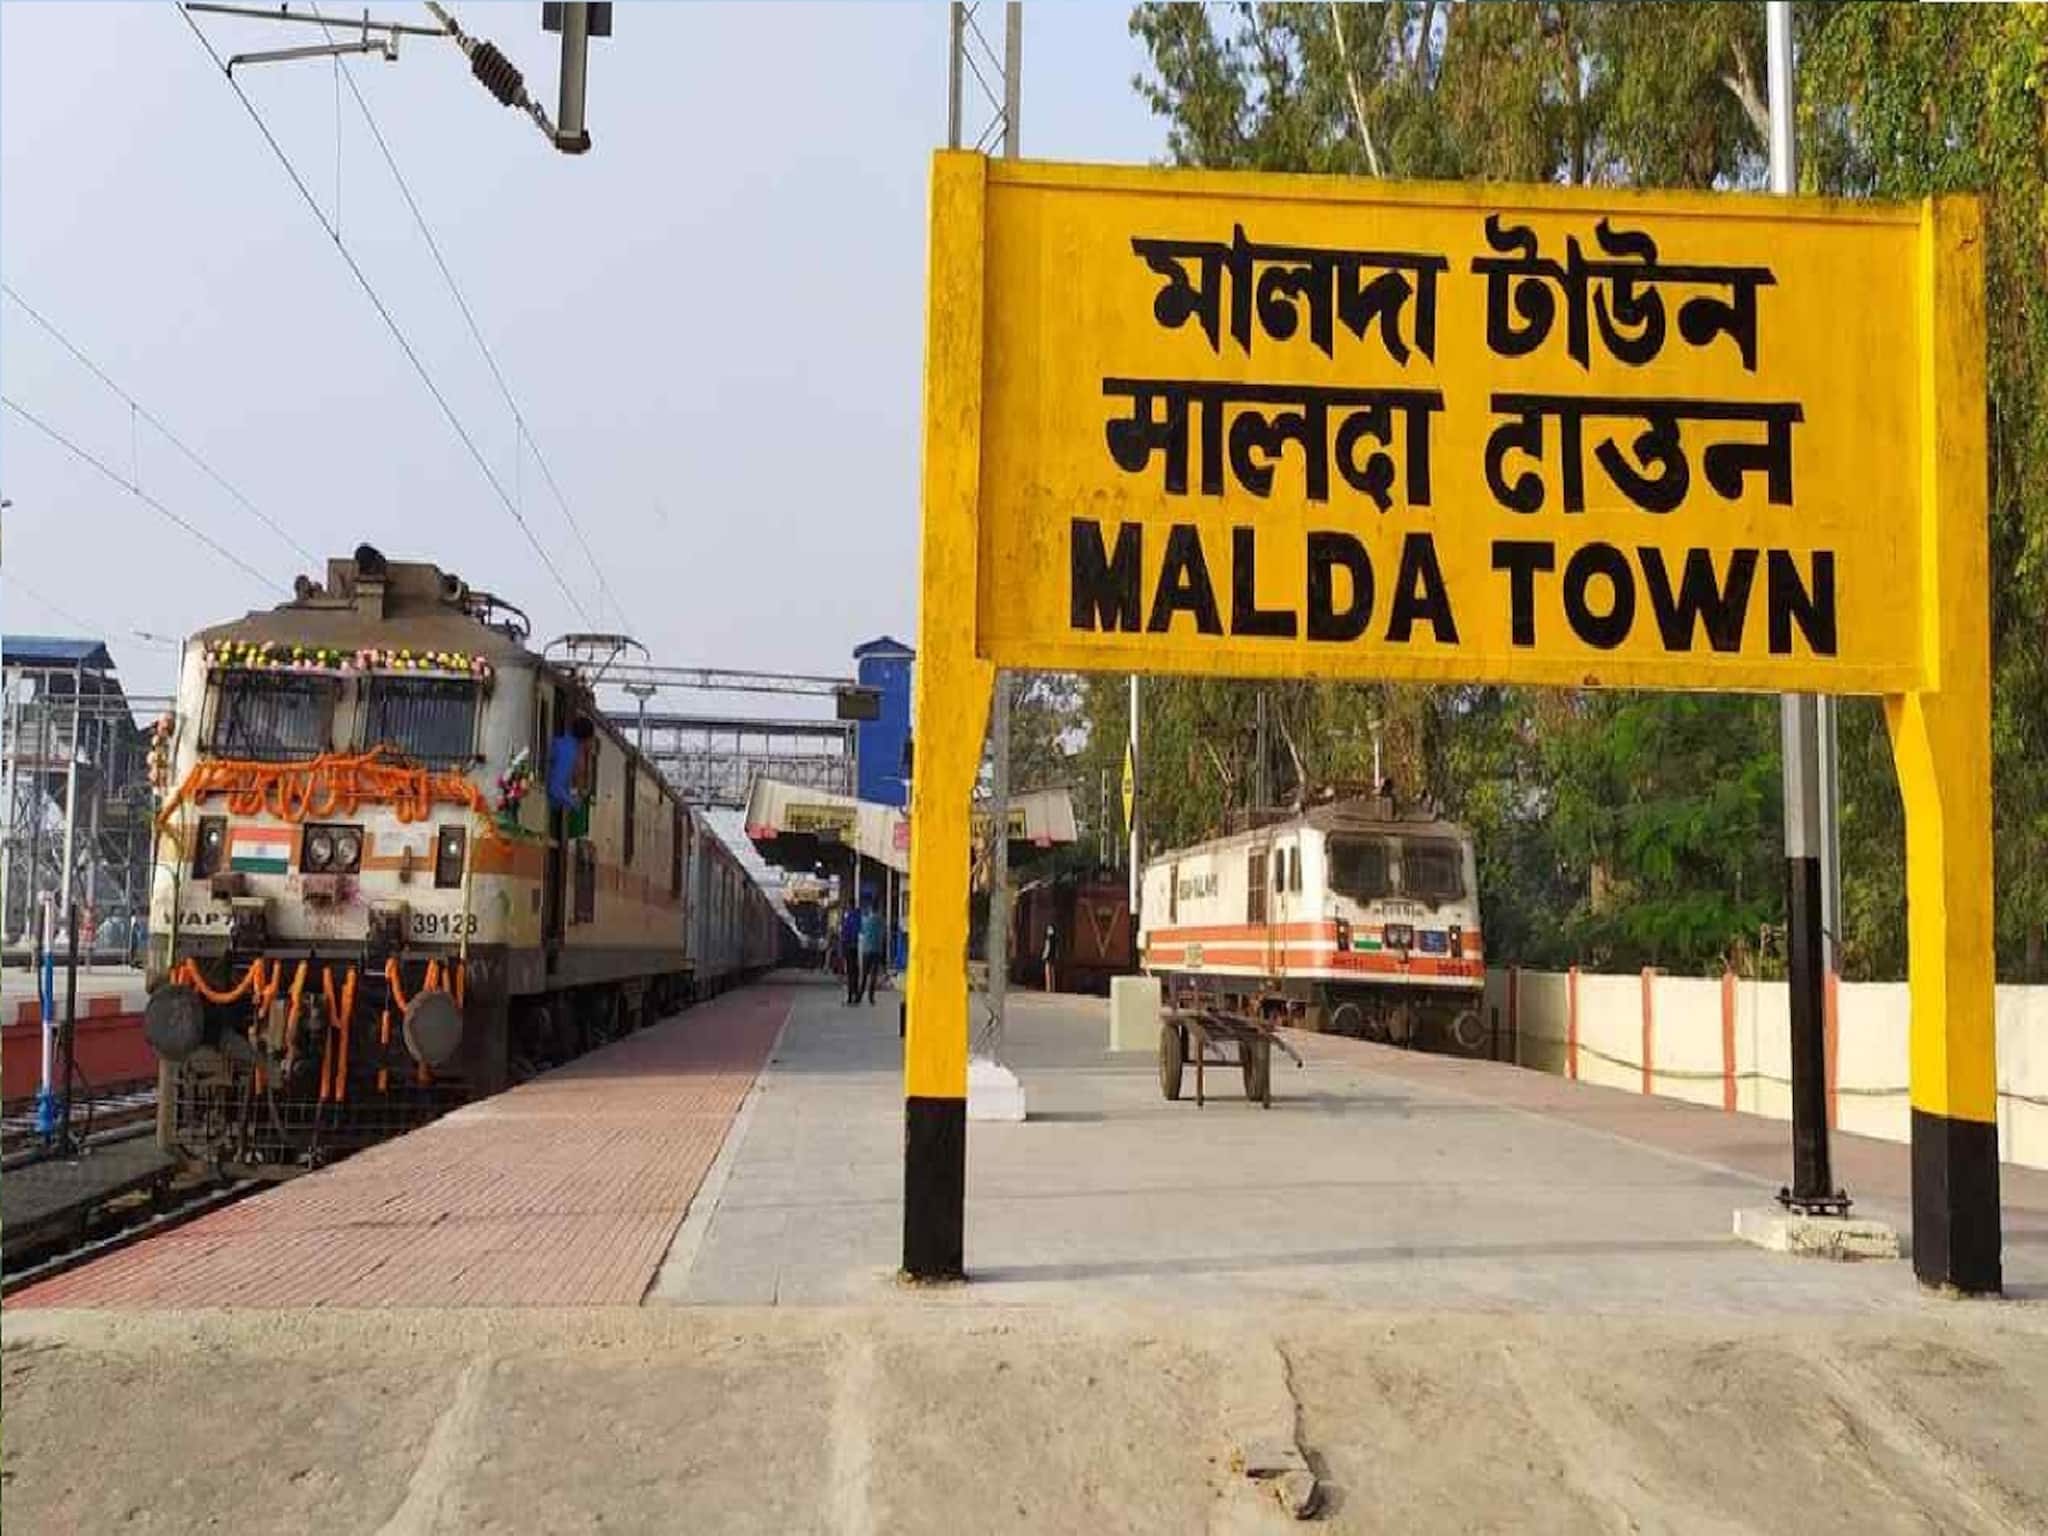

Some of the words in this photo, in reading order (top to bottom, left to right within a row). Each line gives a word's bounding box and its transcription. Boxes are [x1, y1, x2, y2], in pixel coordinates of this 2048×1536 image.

[1131, 223, 1449, 367] মালদা
[1471, 213, 1777, 372] টাউন
[1102, 377, 1445, 514] मालदा
[1070, 517, 1460, 645] MALDA
[1491, 540, 1837, 657] TOWN
[412, 912, 479, 936] 39128
